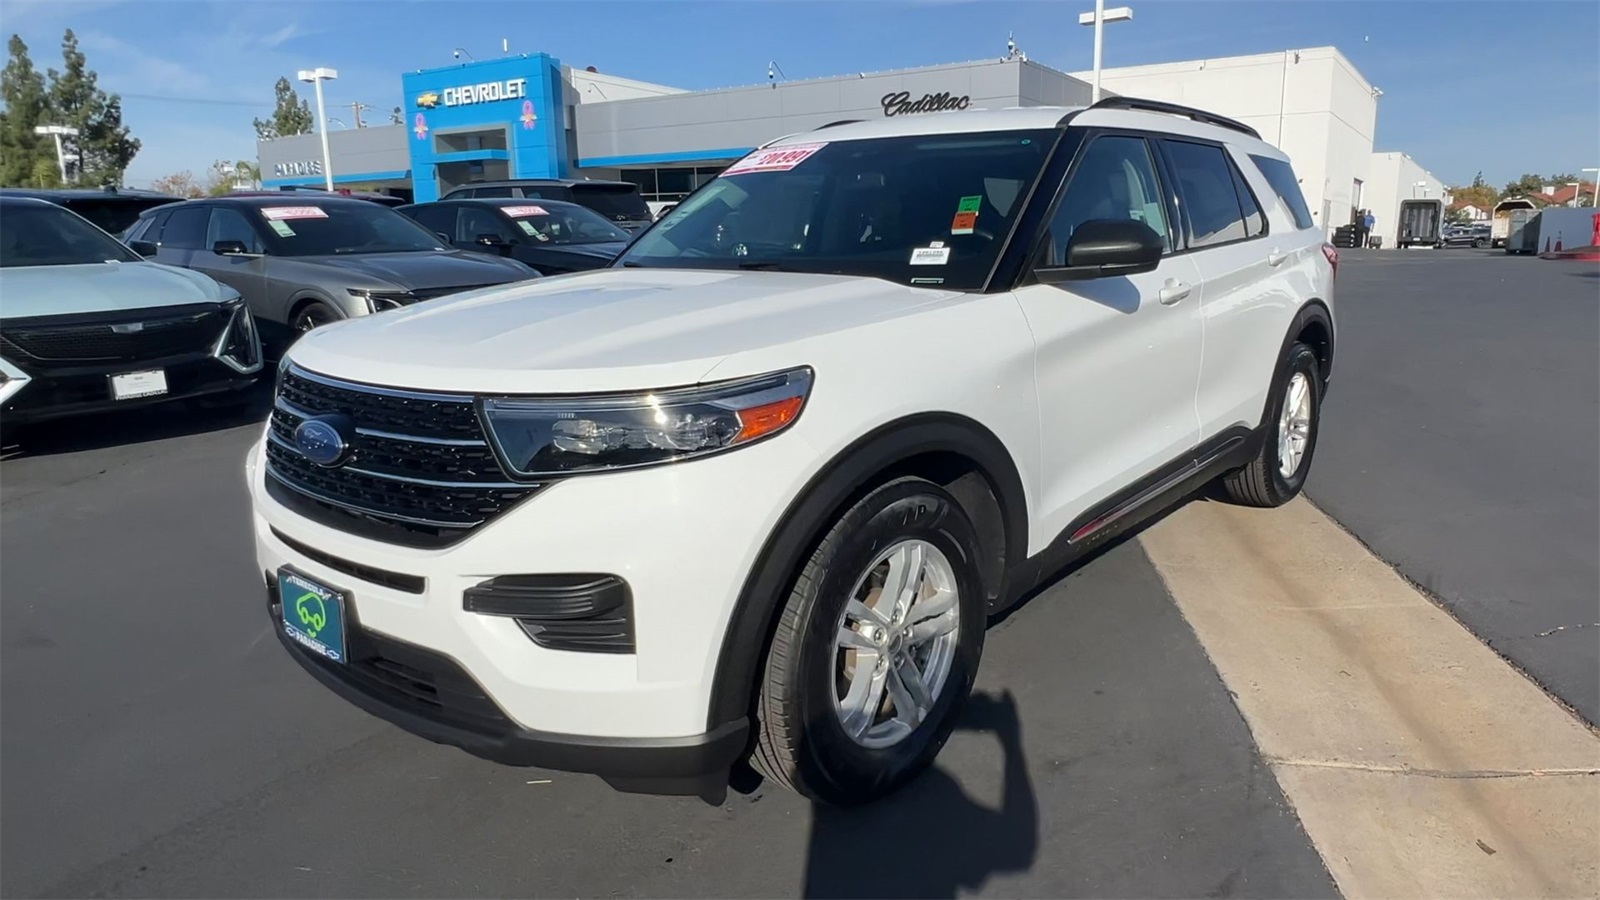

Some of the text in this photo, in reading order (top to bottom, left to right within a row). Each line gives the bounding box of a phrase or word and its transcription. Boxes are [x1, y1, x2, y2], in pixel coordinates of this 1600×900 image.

[444, 79, 526, 106] CHEVROLET
[881, 91, 970, 117] Cadillac
[291, 575, 325, 597] TEMECULA
[295, 631, 327, 655] PARADISE
